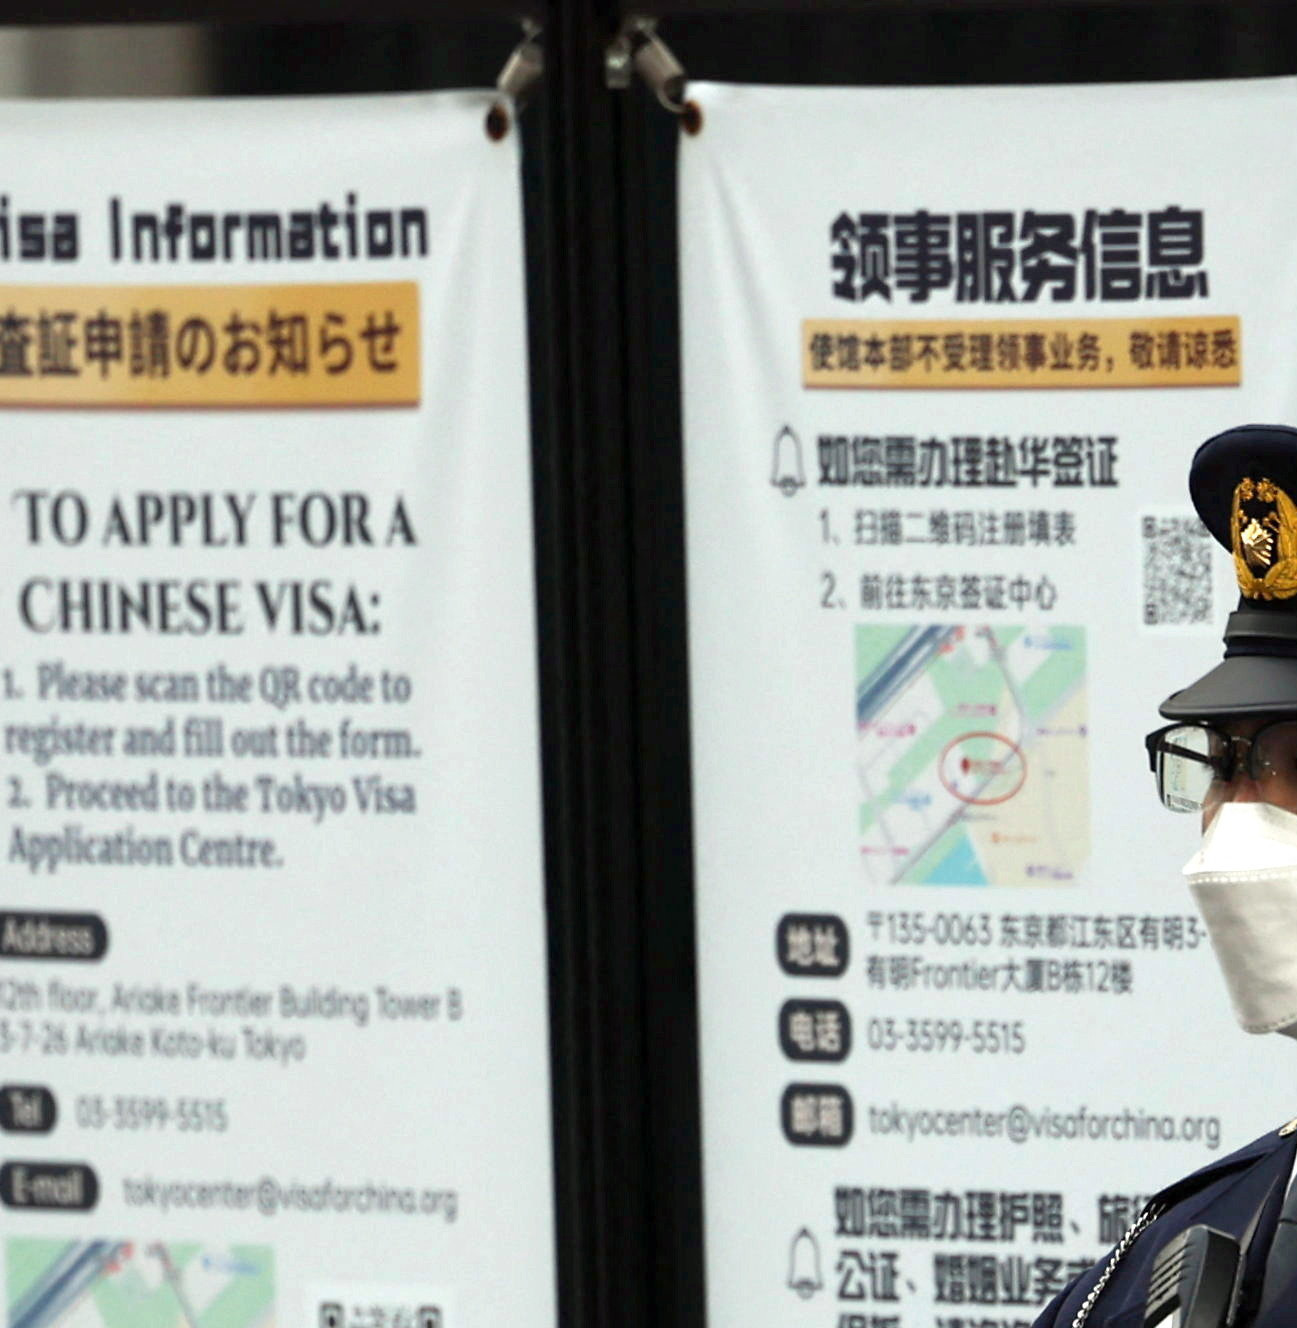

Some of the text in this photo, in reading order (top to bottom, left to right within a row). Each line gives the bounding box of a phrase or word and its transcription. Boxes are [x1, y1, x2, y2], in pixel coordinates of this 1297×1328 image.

[109, 191, 430, 263] Information
[829, 204, 1210, 304] 领事服务信息
[816, 434, 1119, 489] 如您需办理赴华签证
[15, 490, 418, 547] TO APPLY FOR A
[18, 578, 381, 636] CHINESE VISA:
[36, 660, 129, 703] Please
[133, 672, 201, 703] scan
[205, 662, 255, 704] the
[257, 664, 303, 712] QR
[306, 662, 375, 705] code
[379, 669, 413, 704] to
[3, 715, 422, 768] register and fill out the form.
[44, 770, 161, 813] Proceed
[164, 777, 197, 813] to
[201, 771, 250, 814] the
[253, 772, 348, 825] Tokyo
[351, 774, 417, 815] Visa
[7, 824, 284, 875] Application Centre.
[0, 918, 96, 958] Address
[278, 983, 371, 1028] Building
[241, 1025, 307, 1067] Tokyo
[866, 1016, 1027, 1055] 03-3599-5515
[10, 1092, 44, 1130] Tel
[867, 1102, 1222, 1152] tokyocenter@visaforchina.org
[11, 1166, 459, 1225] E-mail tokyocenter@visaforchina.org
[832, 1184, 1154, 1244] 如您需办理护照、旅
